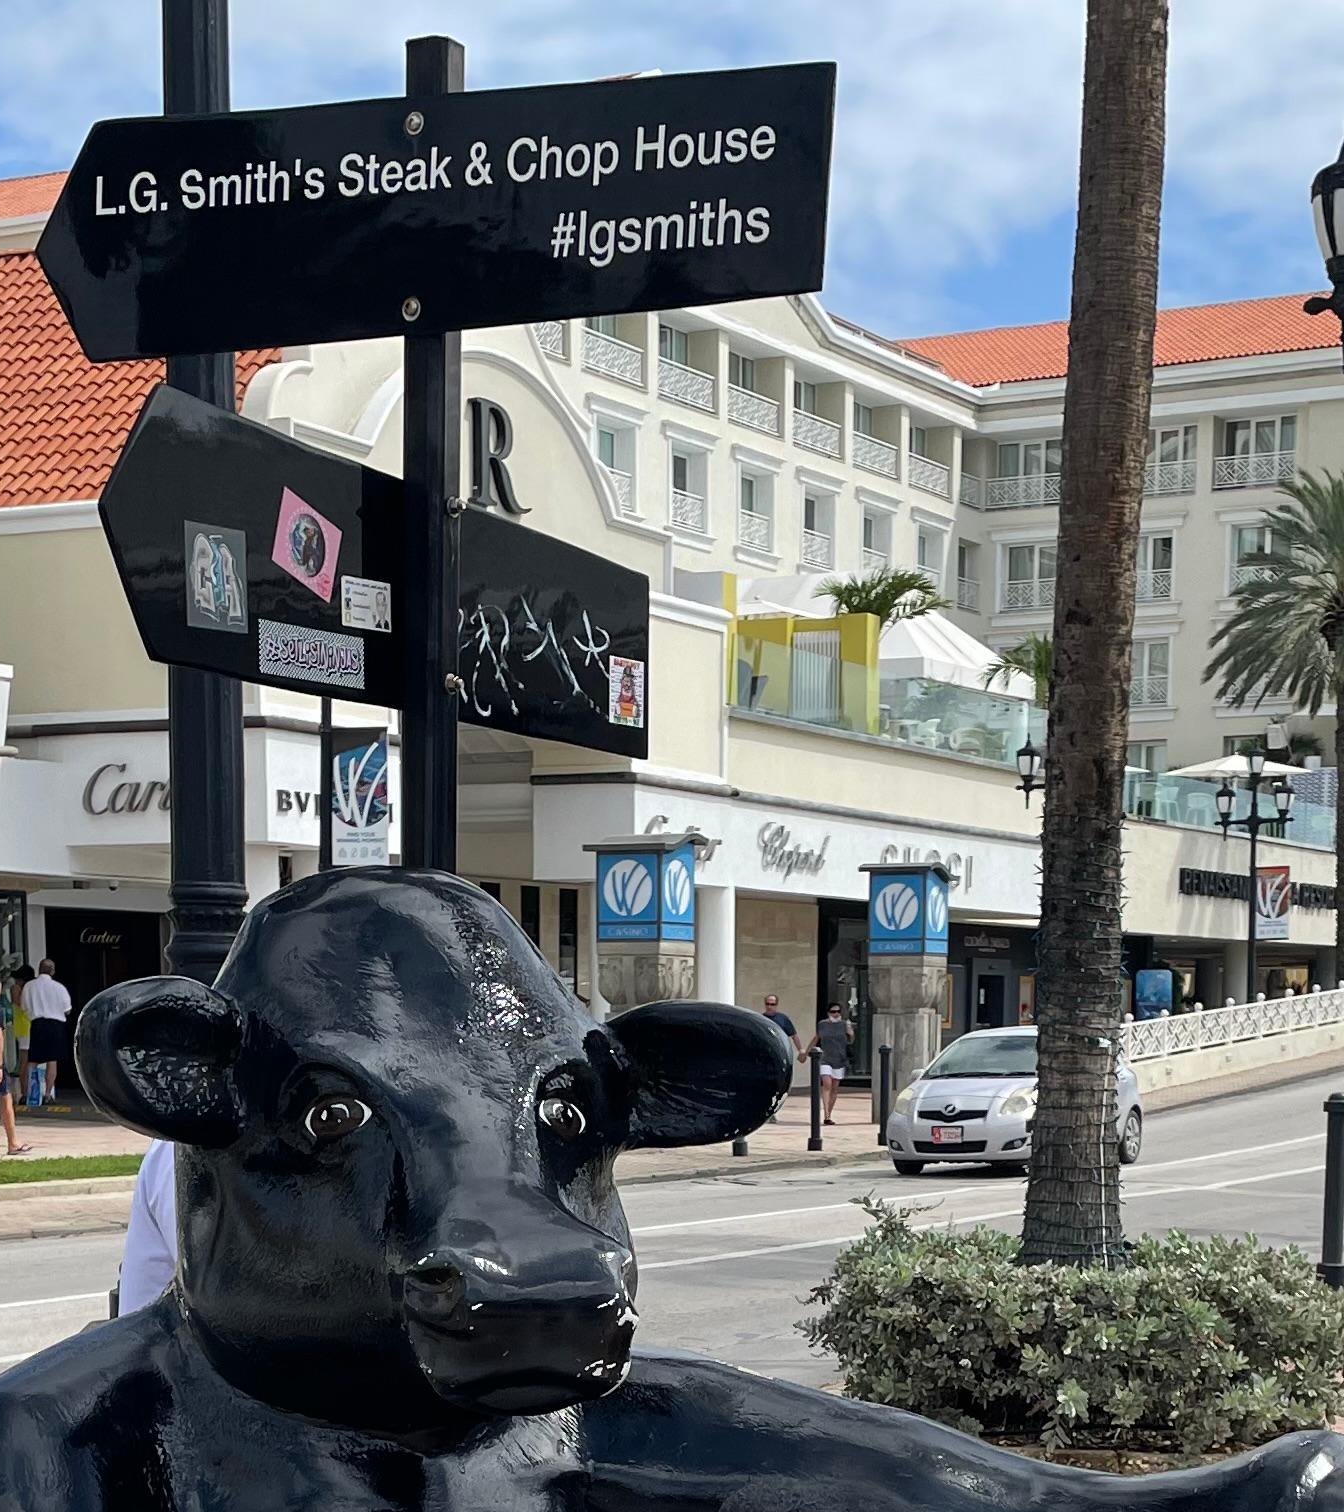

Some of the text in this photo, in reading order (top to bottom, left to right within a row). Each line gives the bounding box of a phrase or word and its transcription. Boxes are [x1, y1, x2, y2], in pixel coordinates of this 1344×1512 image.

[95, 124, 776, 216] L.G. Smith's Steak & Chop House
[550, 198, 770, 267] #lgsmiths
[465, 397, 533, 514] R
[79, 926, 124, 944] Cartier
